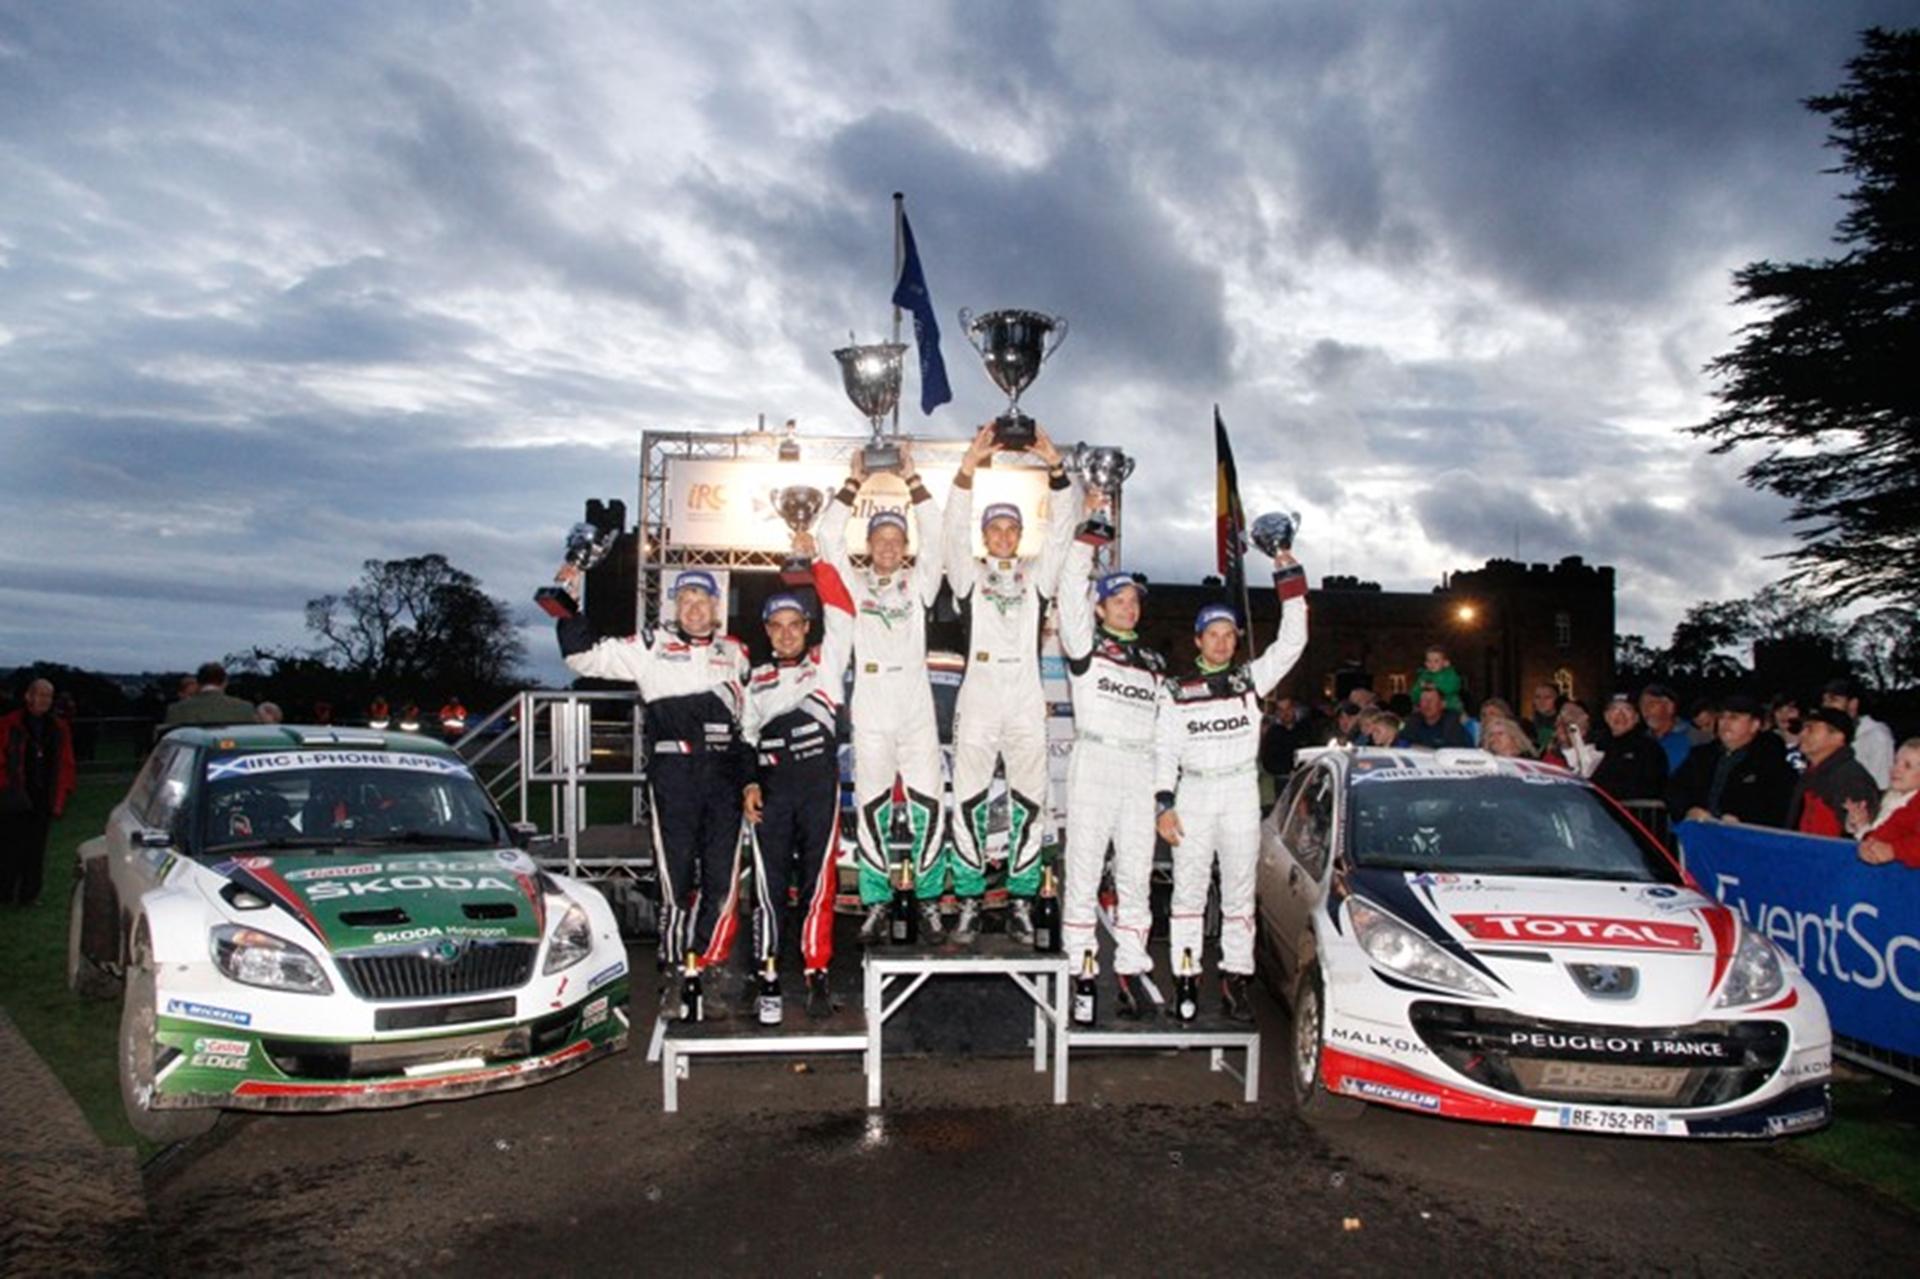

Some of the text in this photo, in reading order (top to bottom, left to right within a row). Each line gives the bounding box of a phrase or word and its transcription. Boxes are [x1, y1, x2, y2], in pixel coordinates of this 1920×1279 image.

[250, 756, 292, 769] IRC
[297, 753, 391, 767] I-PHONE
[305, 876, 515, 901] ŠKODA
[373, 926, 443, 943] ŠKODA
[1485, 916, 1680, 946] TOTAL
[1511, 1033, 1723, 1057] PEUGEOT FRANCE
[191, 1054, 251, 1071] EDGE
[1363, 1083, 1437, 1107] MICHELIN
[1573, 1110, 1655, 1129] BE-752-PR
